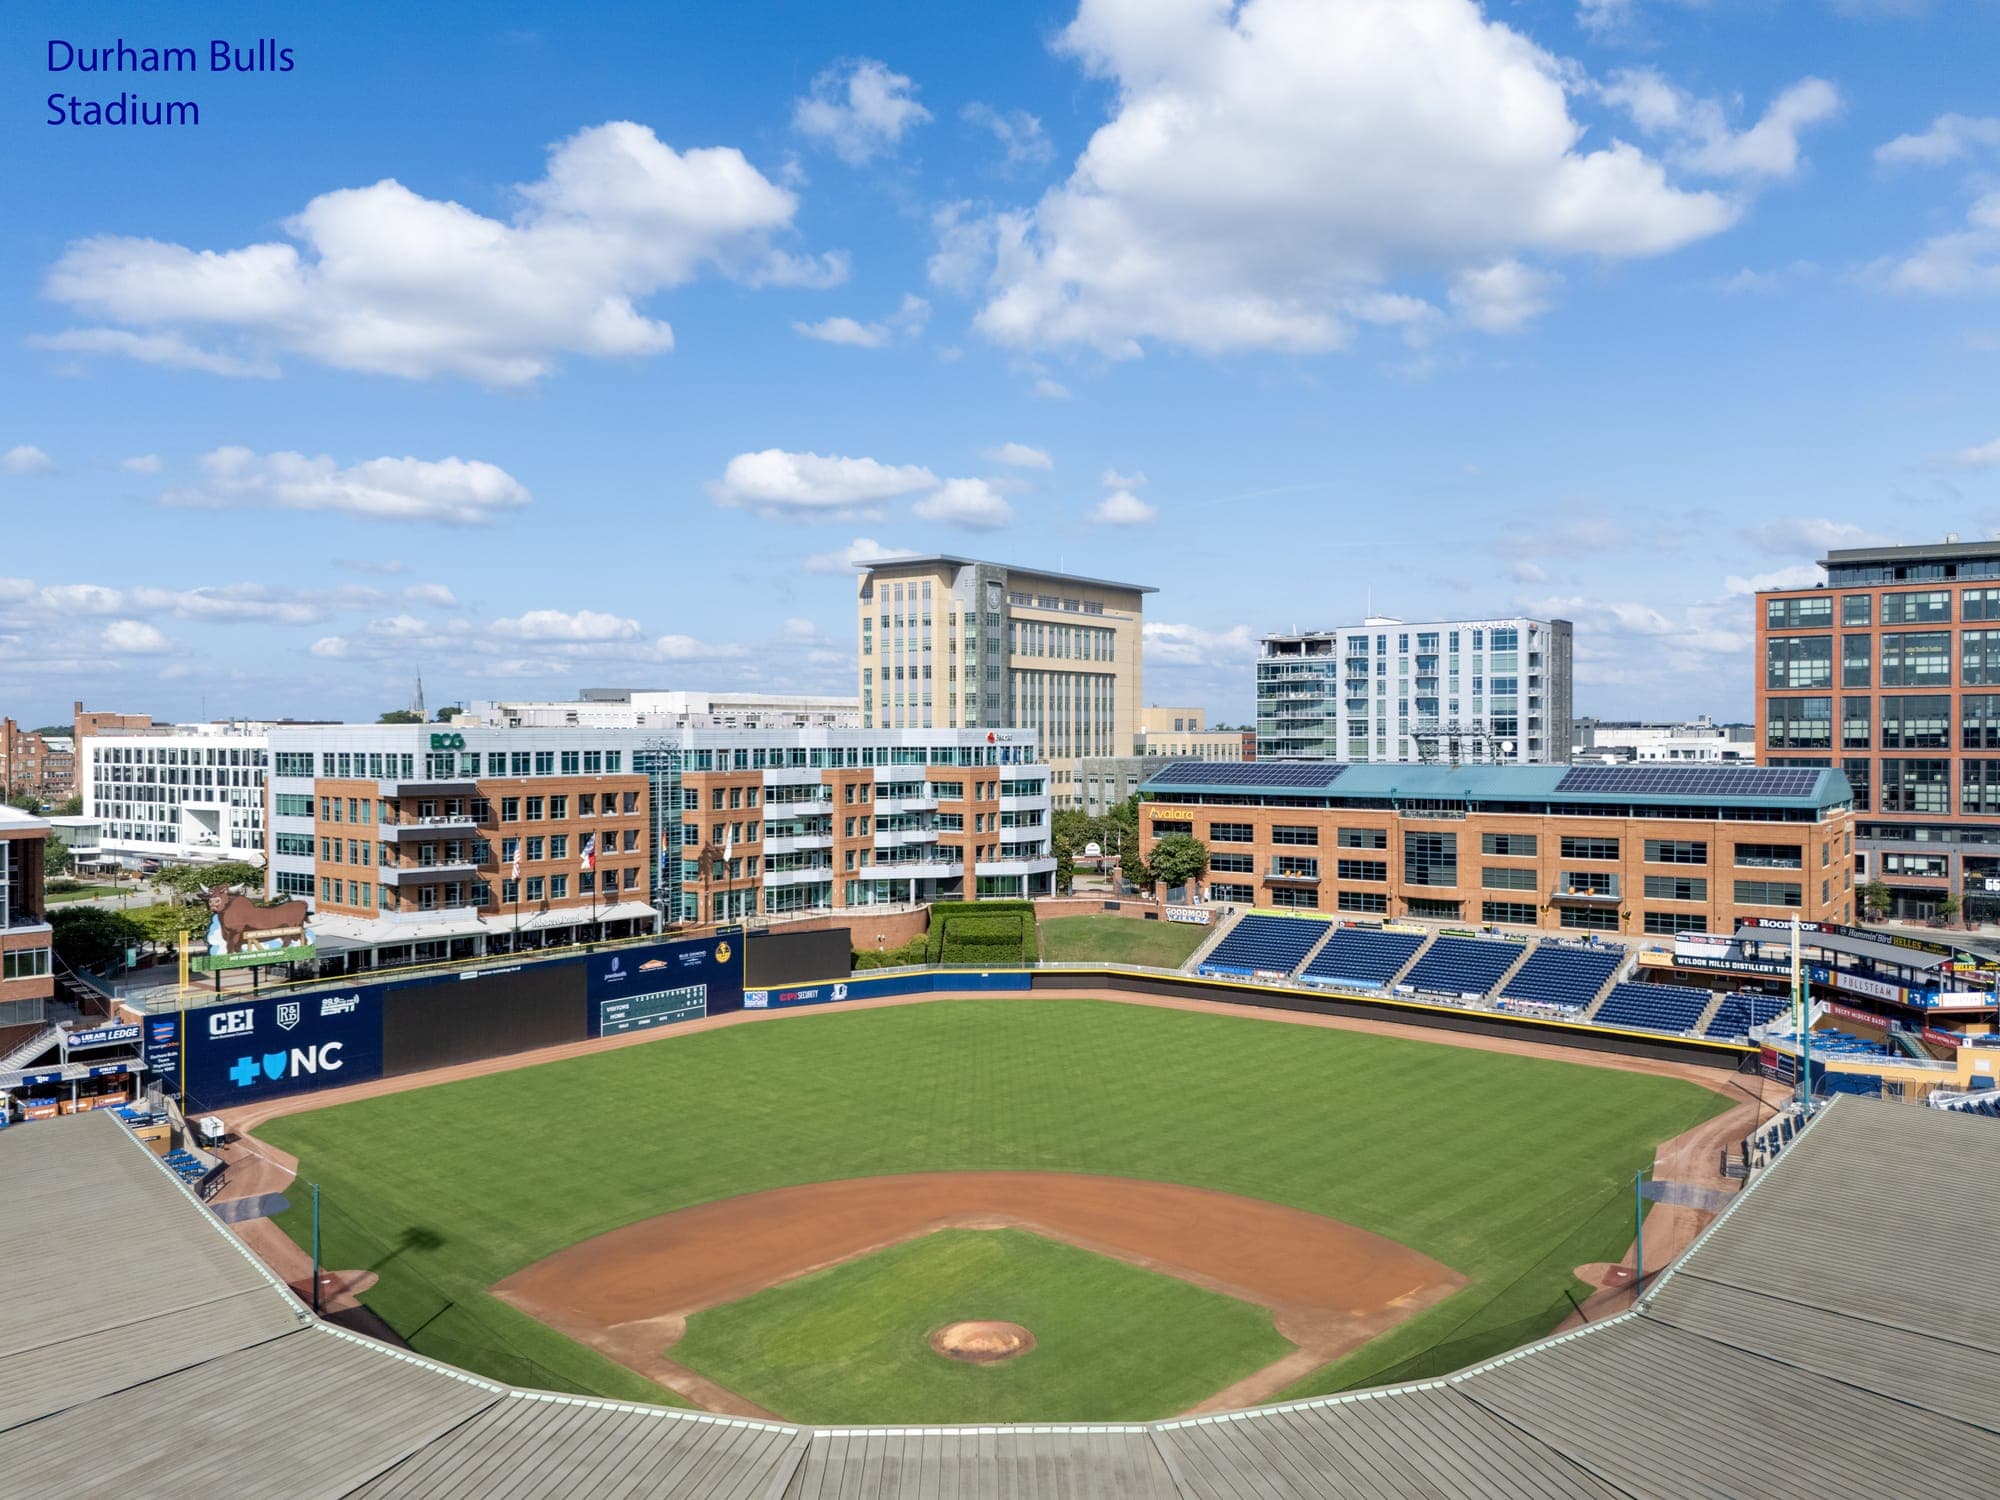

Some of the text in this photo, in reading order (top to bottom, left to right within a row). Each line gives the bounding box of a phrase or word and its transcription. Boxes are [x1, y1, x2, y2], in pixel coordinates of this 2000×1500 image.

[431, 733, 465, 749] BCG
[1149, 806, 1194, 820] Avalara
[1759, 918, 1818, 931] ROOFOP
[1893, 936, 1922, 950] HELLES
[1677, 957, 1707, 967] WELDON
[1708, 960, 1731, 969] MILLS
[1731, 961, 1773, 973] DISTILLERY
[1843, 976, 1891, 996] FULLSTEAM
[209, 1008, 255, 1035] CEI
[107, 1027, 139, 1040] LEDGE
[291, 1041, 344, 1077] NC
